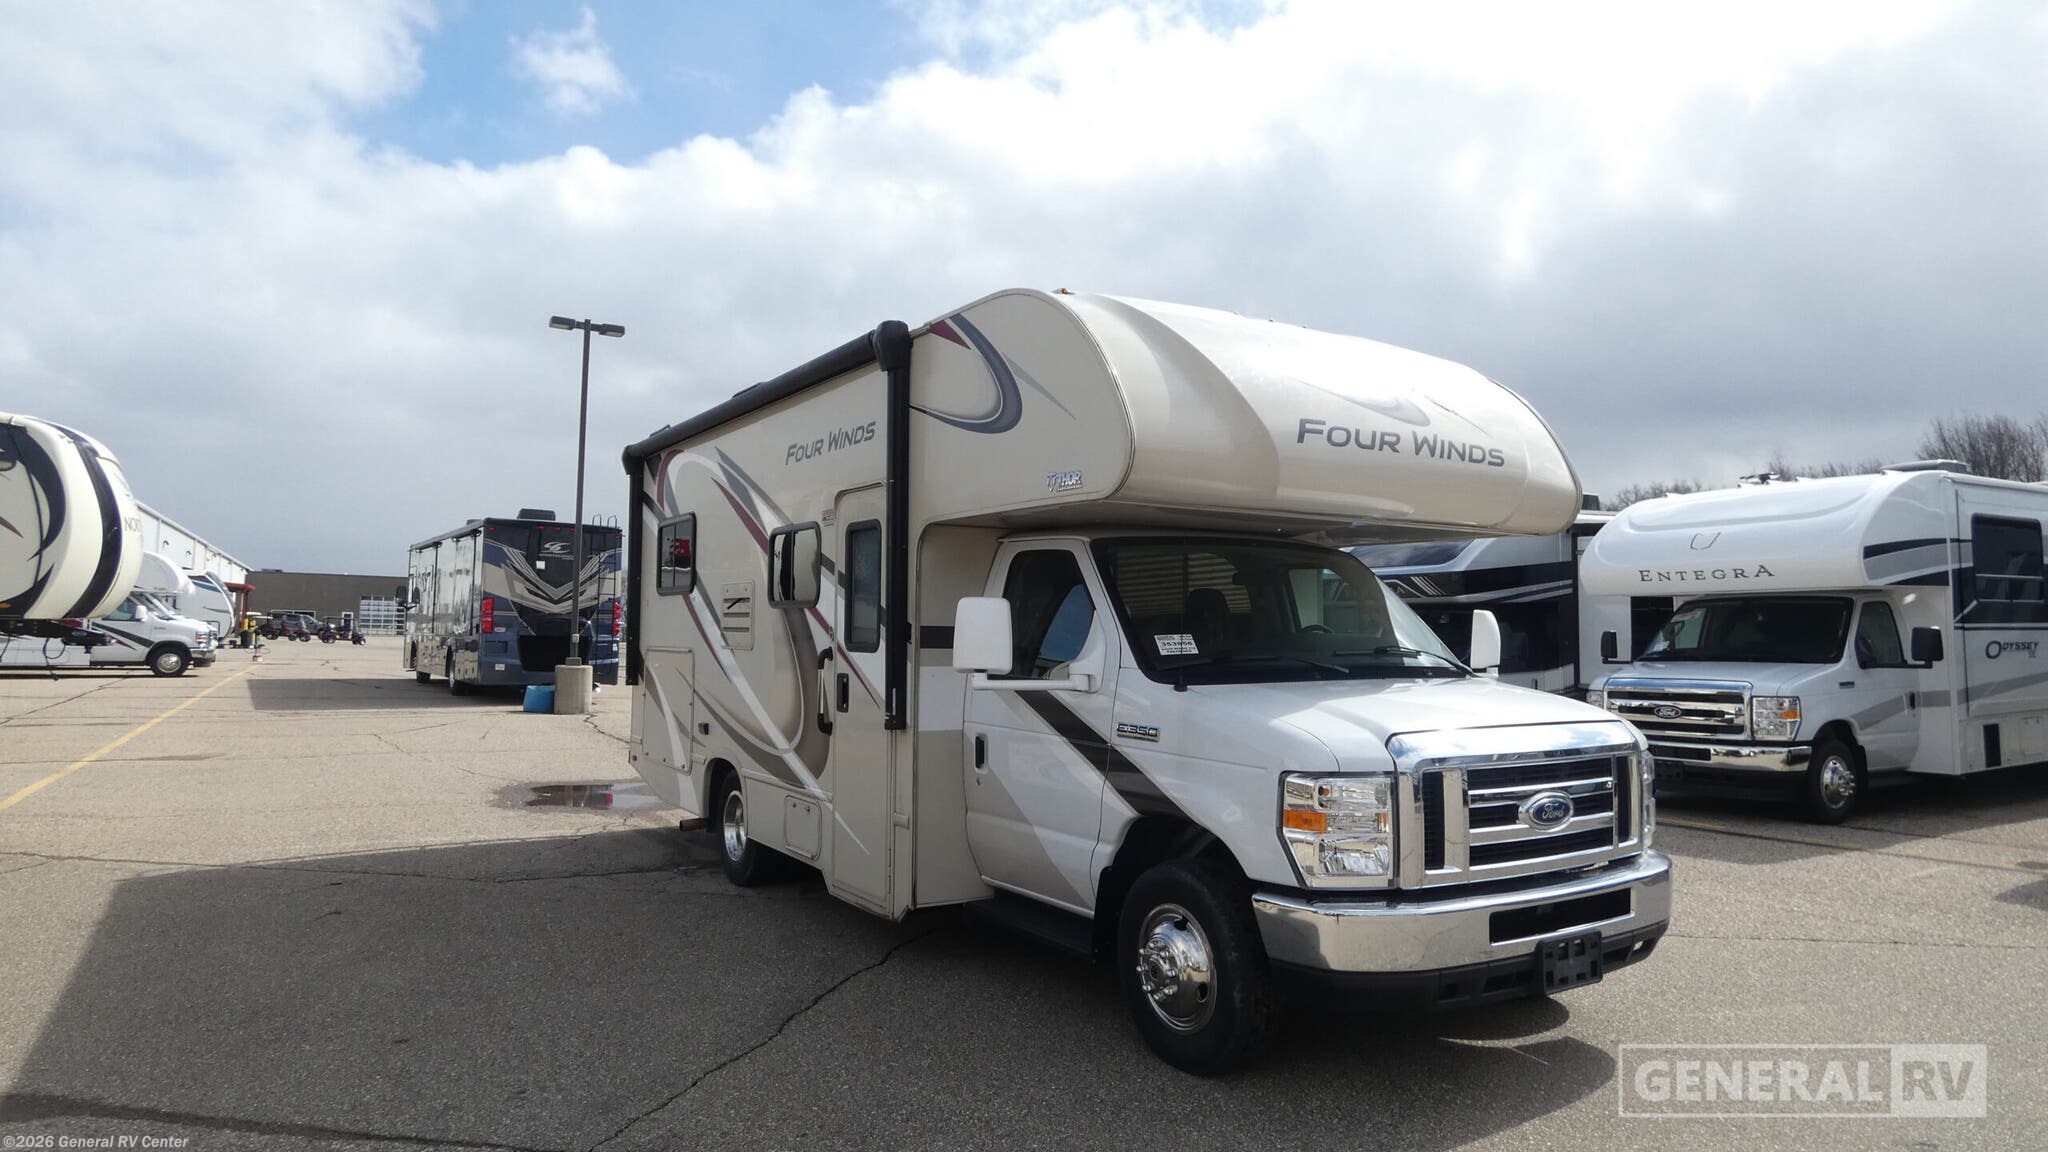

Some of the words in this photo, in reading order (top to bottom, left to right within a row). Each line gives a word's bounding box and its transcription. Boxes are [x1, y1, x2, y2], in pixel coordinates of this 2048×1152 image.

[785, 438, 824, 466] FOUR
[828, 421, 876, 453] WINDS
[1297, 418, 1400, 453] FOUR
[1412, 430, 1505, 467] WINDS
[1639, 564, 1775, 582] ENTEGRA
[1986, 640, 2039, 659] ODYSSEY
[1541, 803, 1565, 819] Ford
